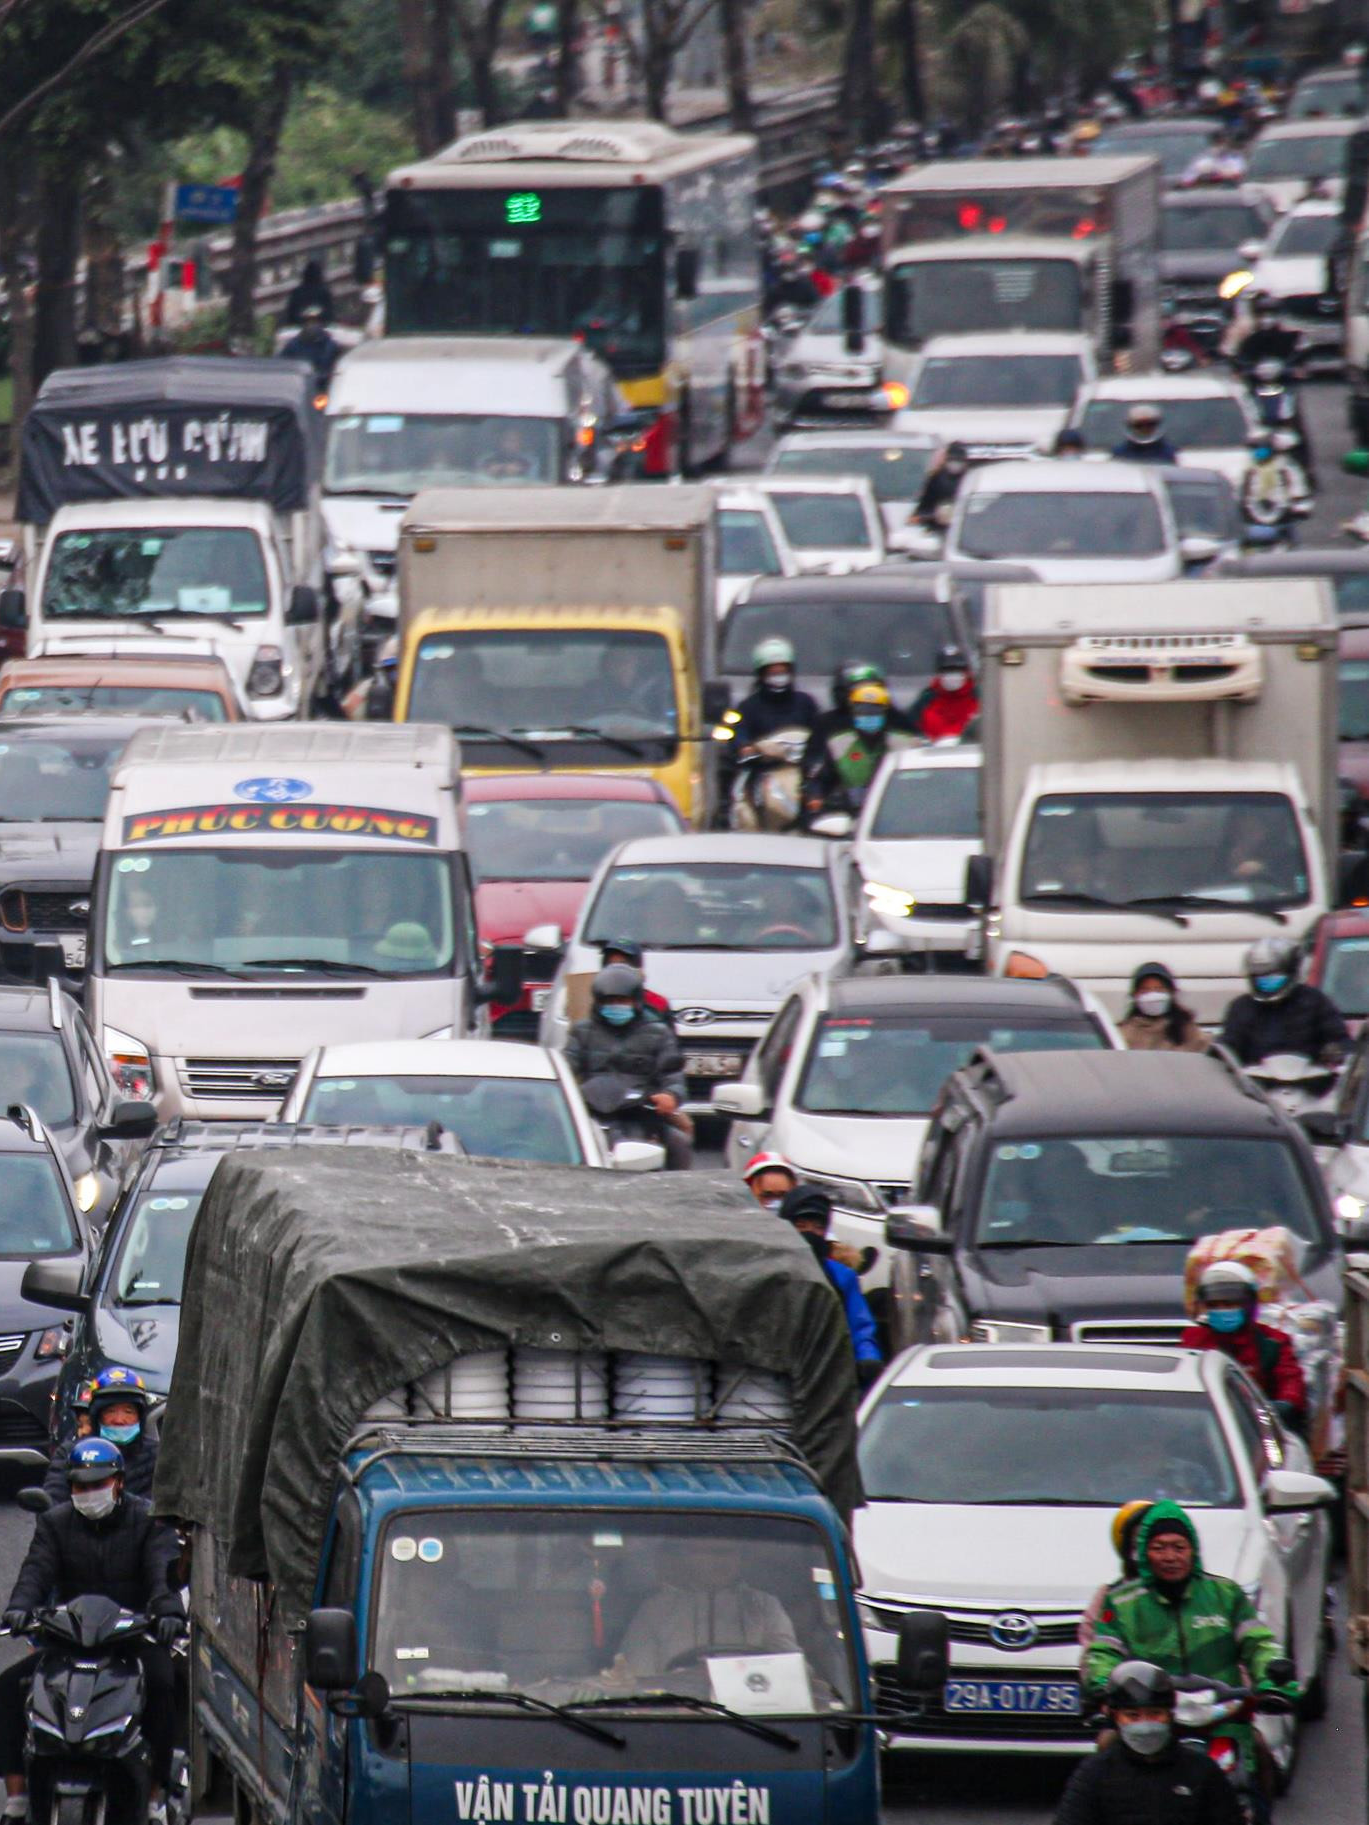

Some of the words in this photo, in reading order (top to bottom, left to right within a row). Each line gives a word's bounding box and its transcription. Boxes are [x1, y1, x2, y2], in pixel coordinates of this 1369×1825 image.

[127, 804, 264, 841] PHÚC
[949, 1684, 1077, 1710] 29A-017.95
[454, 1774, 514, 1825] VẬN
[521, 1770, 567, 1823] TẢI
[572, 1786, 672, 1825] QUANG
[677, 1779, 771, 1825] TUYÊN
